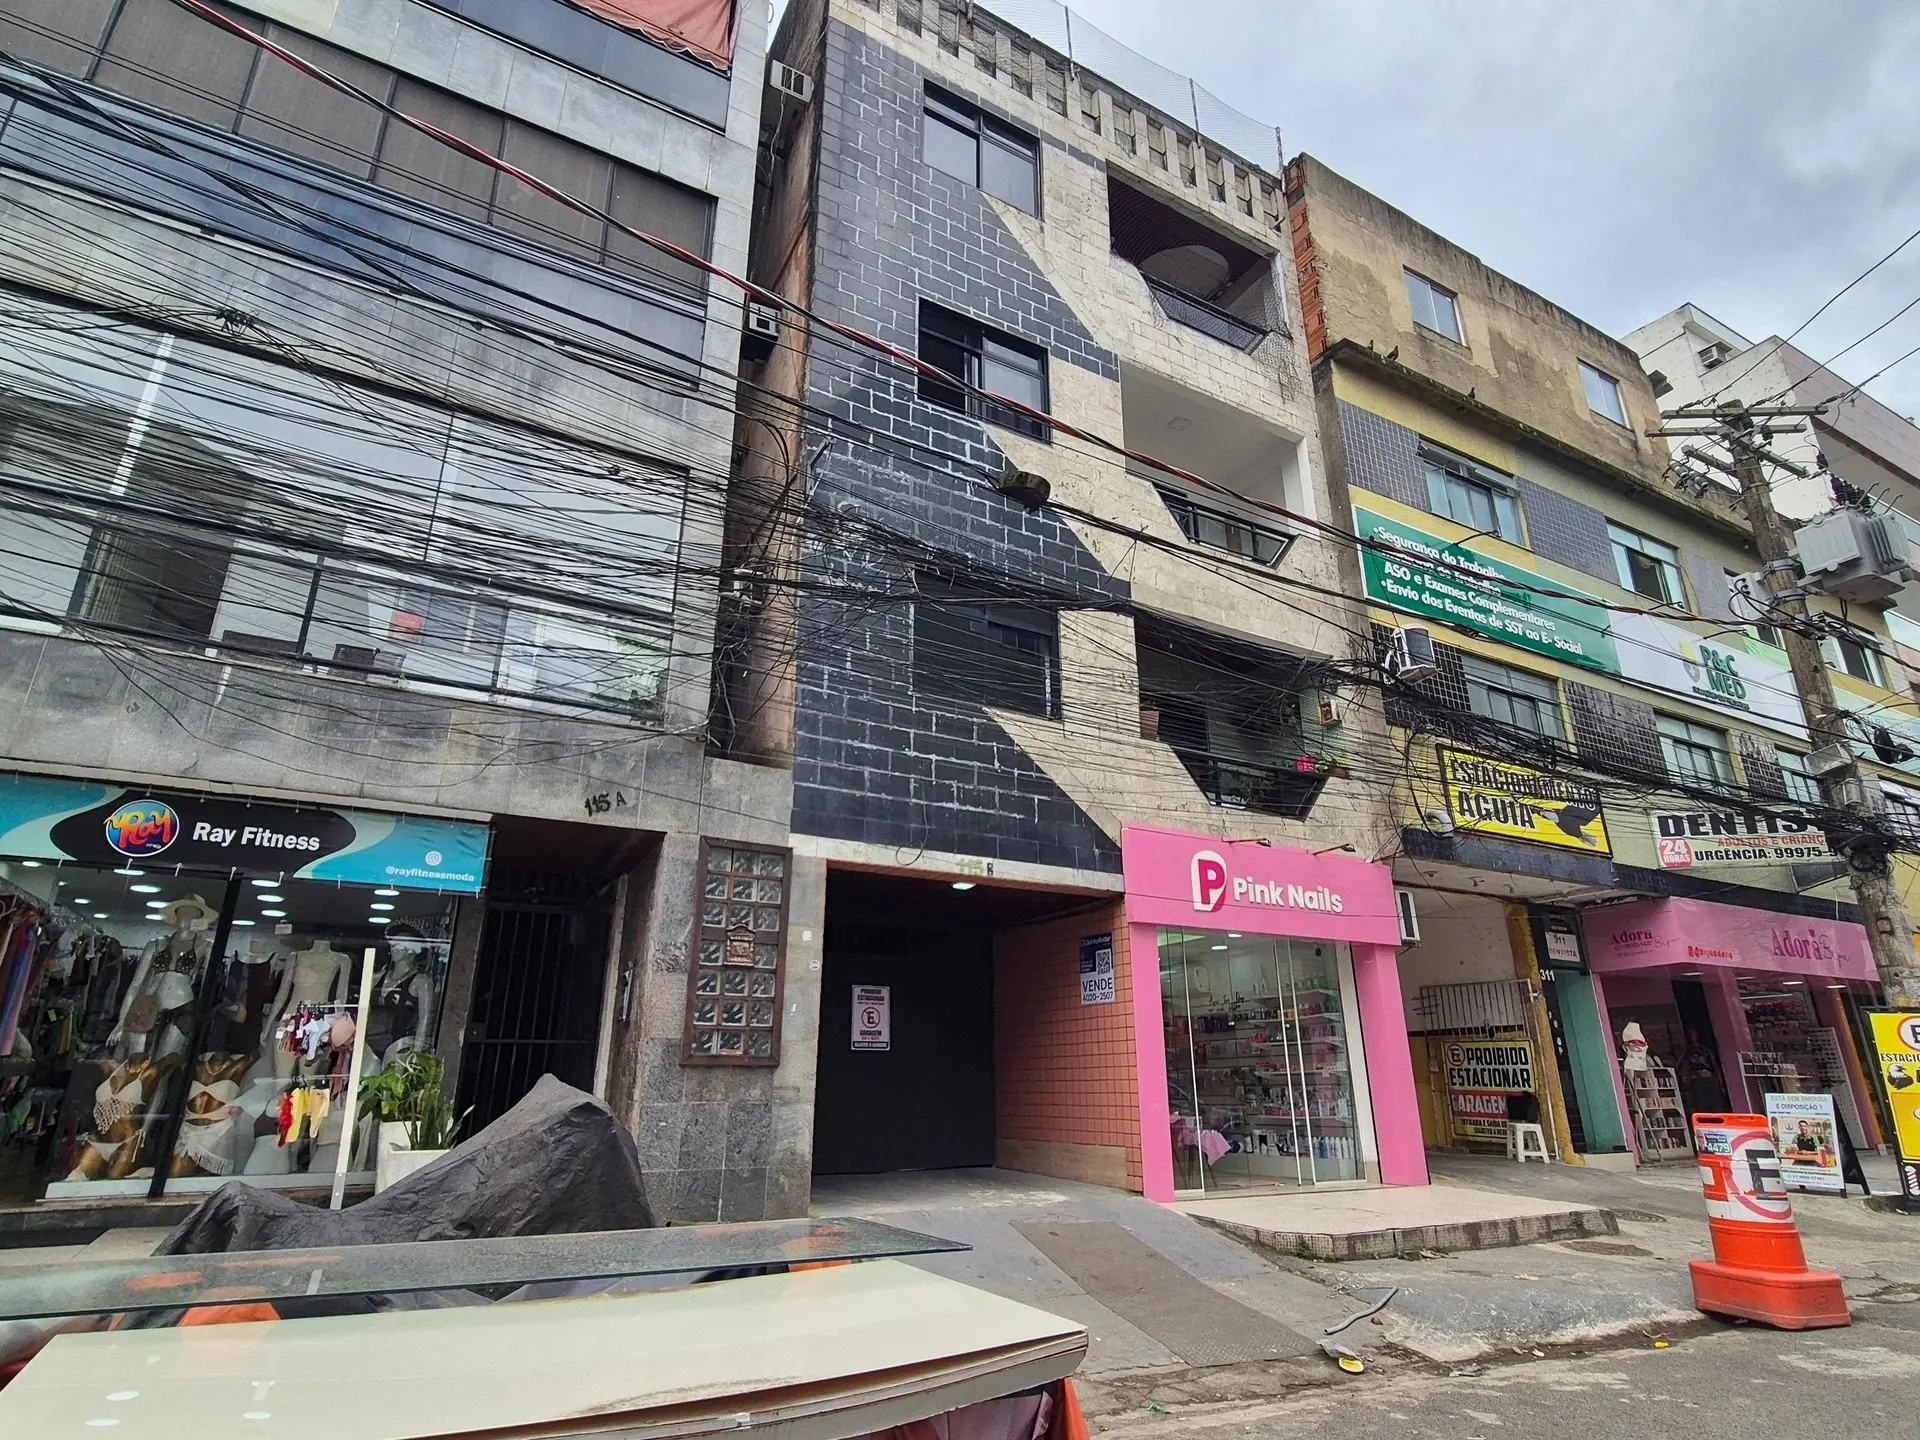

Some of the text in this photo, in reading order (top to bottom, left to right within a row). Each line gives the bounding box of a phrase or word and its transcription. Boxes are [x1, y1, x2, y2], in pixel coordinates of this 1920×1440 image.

[1379, 526, 1440, 559] Segurança
[1441, 550, 1456, 565] do
[1385, 561, 1556, 630] ASO e Exames Complementares
[1386, 578, 1420, 600] Envio
[1421, 591, 1443, 609] dos
[1444, 598, 1487, 624] Eventos
[1488, 614, 1503, 629] de
[1505, 619, 1524, 636] SST
[1526, 629, 1540, 641] ao
[1554, 635, 1584, 655] Social
[1699, 644, 1739, 677] P&C
[1706, 669, 1747, 700] MED
[584, 791, 627, 817] 115 A
[192, 823, 321, 851] Ray Fitness
[1660, 839, 1688, 855] 24
[1770, 836, 1778, 845] E
[1663, 854, 1691, 863] HORAS
[1694, 848, 1772, 861] URGÊNCIA:
[385, 866, 474, 883] @rayfitnessmoda
[1233, 877, 1343, 913] Pink Nails
[1611, 930, 1654, 945] Adora
[1772, 927, 1823, 960] Adora
[1082, 977, 1113, 992] VENDE
[1540, 969, 1556, 981] 311
[1082, 991, 1114, 1002] 4020-2507
[1466, 1046, 1529, 1066] PROIBIDO
[1449, 1067, 1532, 1088] ESTACIONAR
[1451, 1094, 1508, 1114] GARAGEM
[1707, 1142, 1730, 1152] 4479
